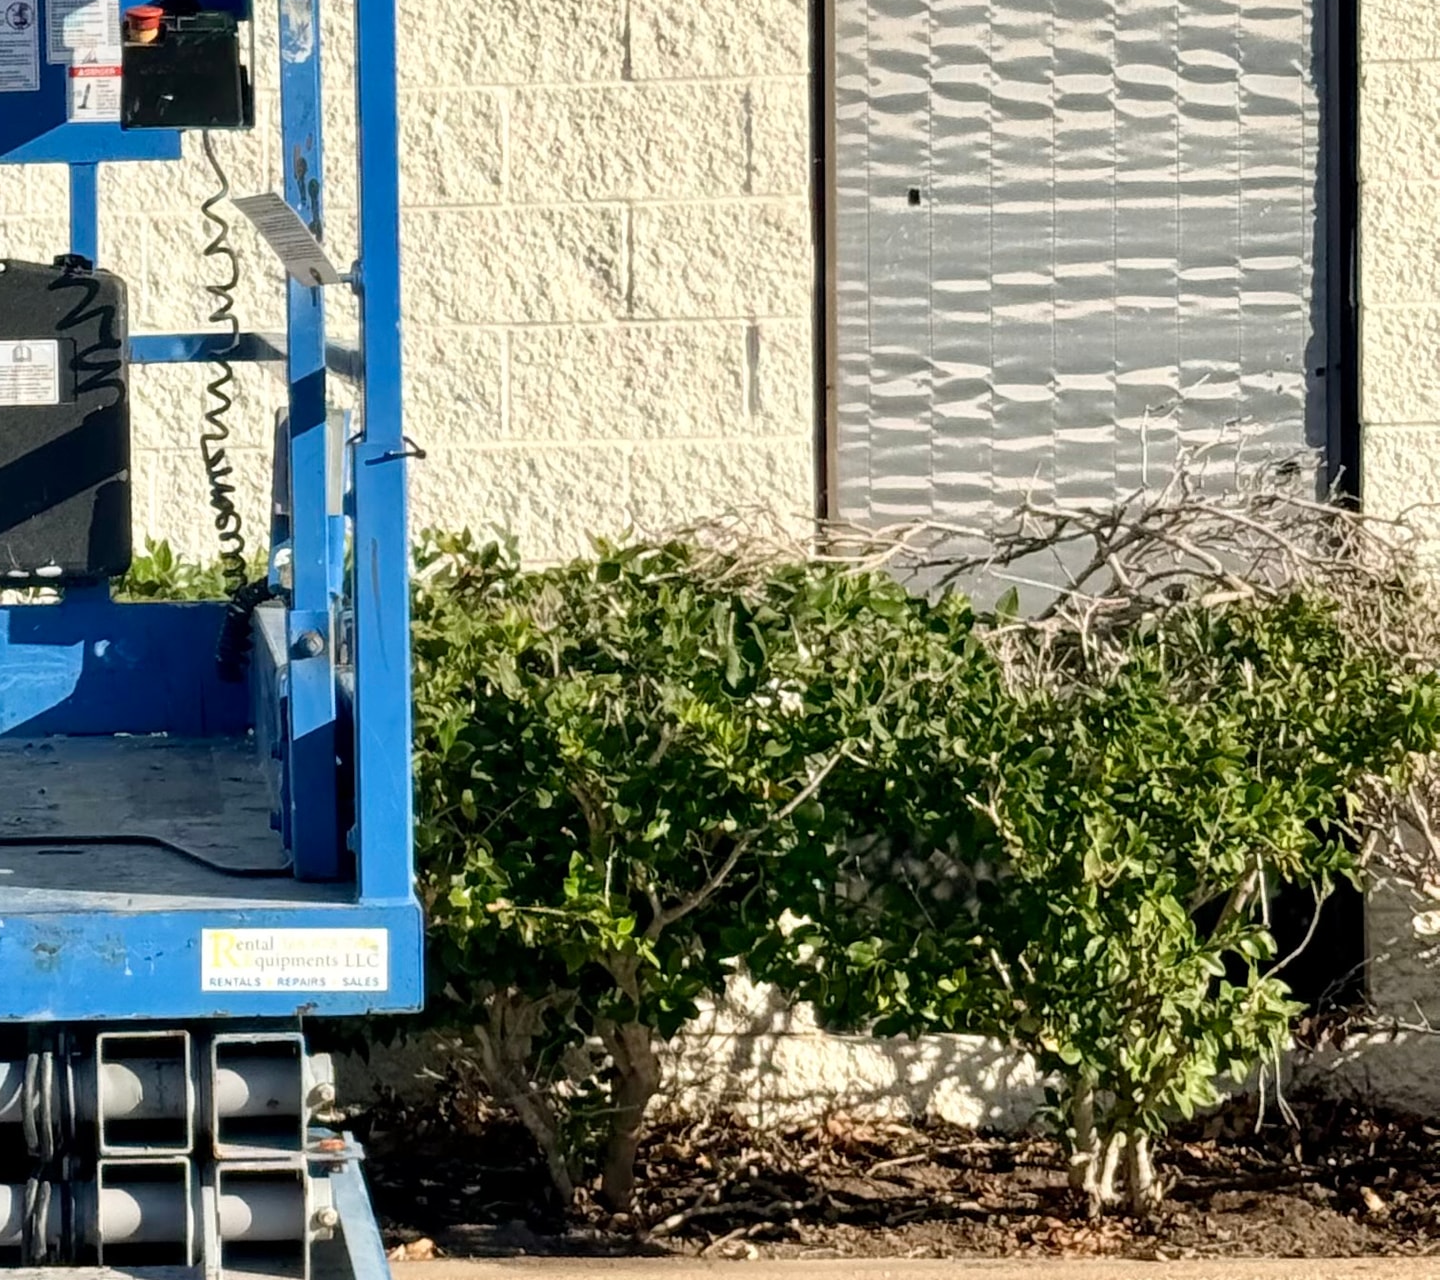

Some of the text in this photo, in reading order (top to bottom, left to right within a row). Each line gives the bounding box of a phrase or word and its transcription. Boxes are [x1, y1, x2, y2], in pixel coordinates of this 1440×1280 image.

[209, 931, 274, 968] Rental
[344, 953, 380, 968] LLC
[209, 977, 380, 987] RENTALS REPAIRS SALES
